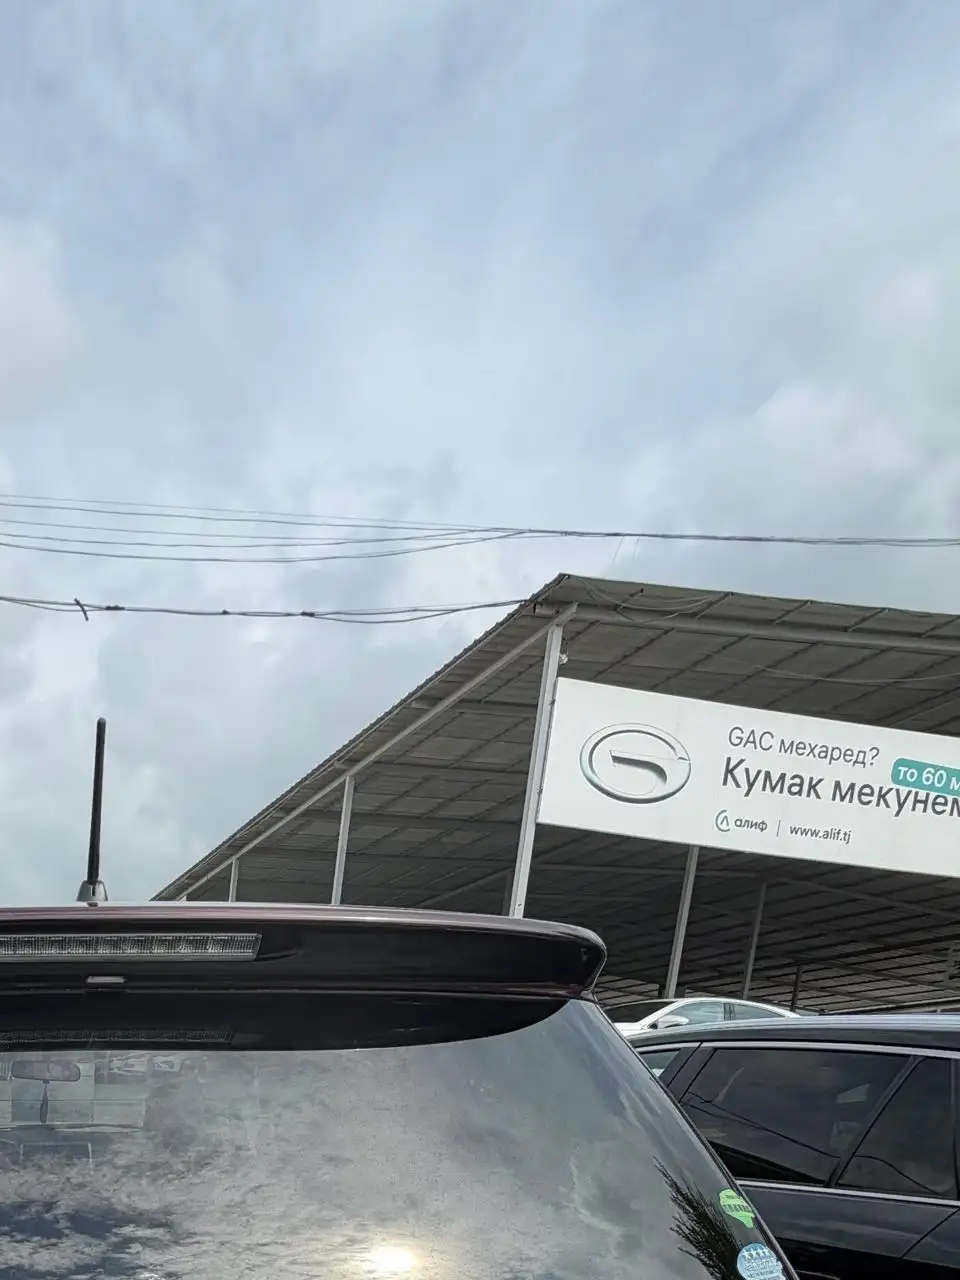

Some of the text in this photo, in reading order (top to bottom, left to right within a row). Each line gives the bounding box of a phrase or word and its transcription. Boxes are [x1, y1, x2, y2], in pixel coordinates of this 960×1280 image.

[728, 726, 880, 767] GAC мехаред?
[722, 756, 825, 800] Кумак
[897, 766, 918, 782] то
[922, 767, 947, 788] 60
[734, 818, 768, 833] алиф
[789, 824, 852, 845] www.alif.tj
